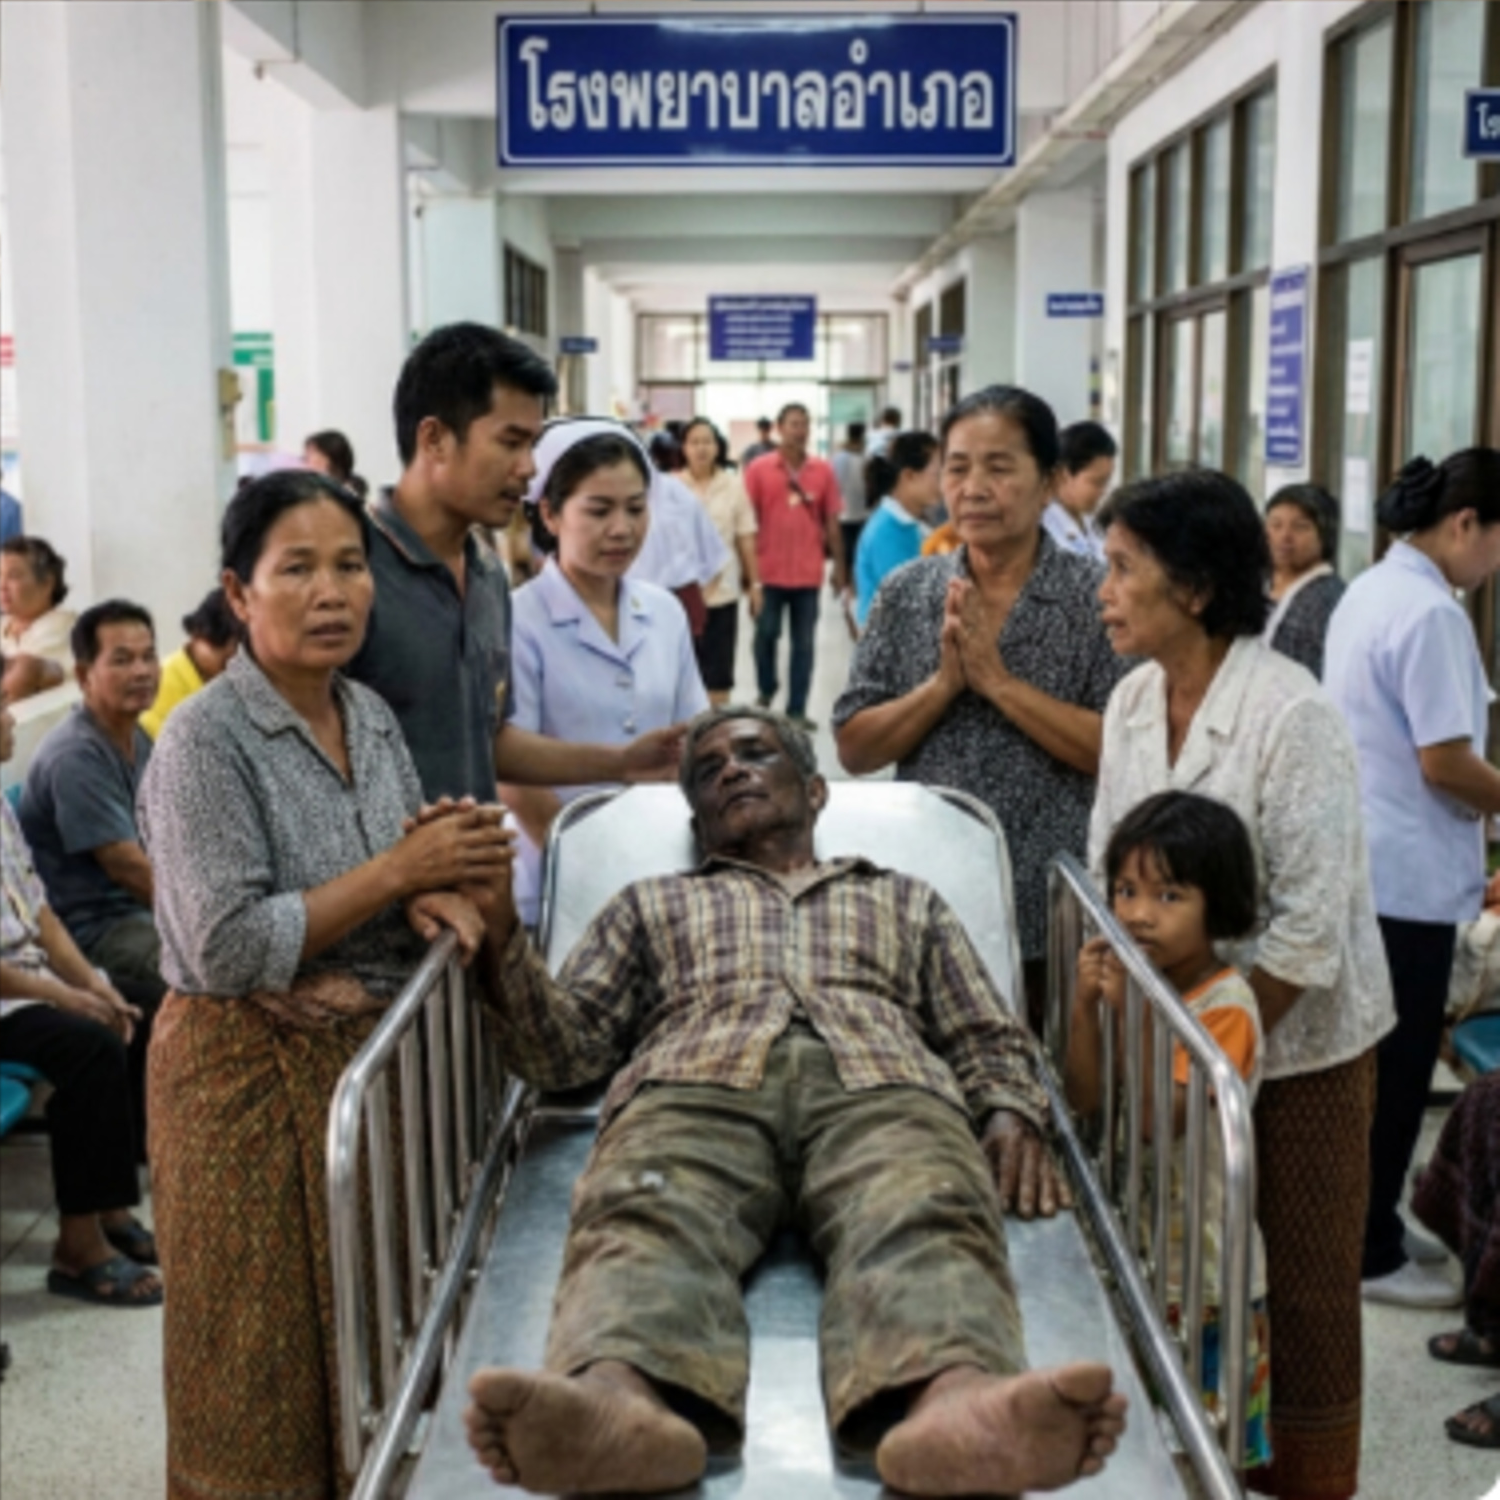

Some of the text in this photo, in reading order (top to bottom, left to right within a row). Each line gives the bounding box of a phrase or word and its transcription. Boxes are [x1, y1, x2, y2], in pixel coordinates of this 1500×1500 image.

[519, 37, 994, 130] โรงพยาบาลอำเภอ
